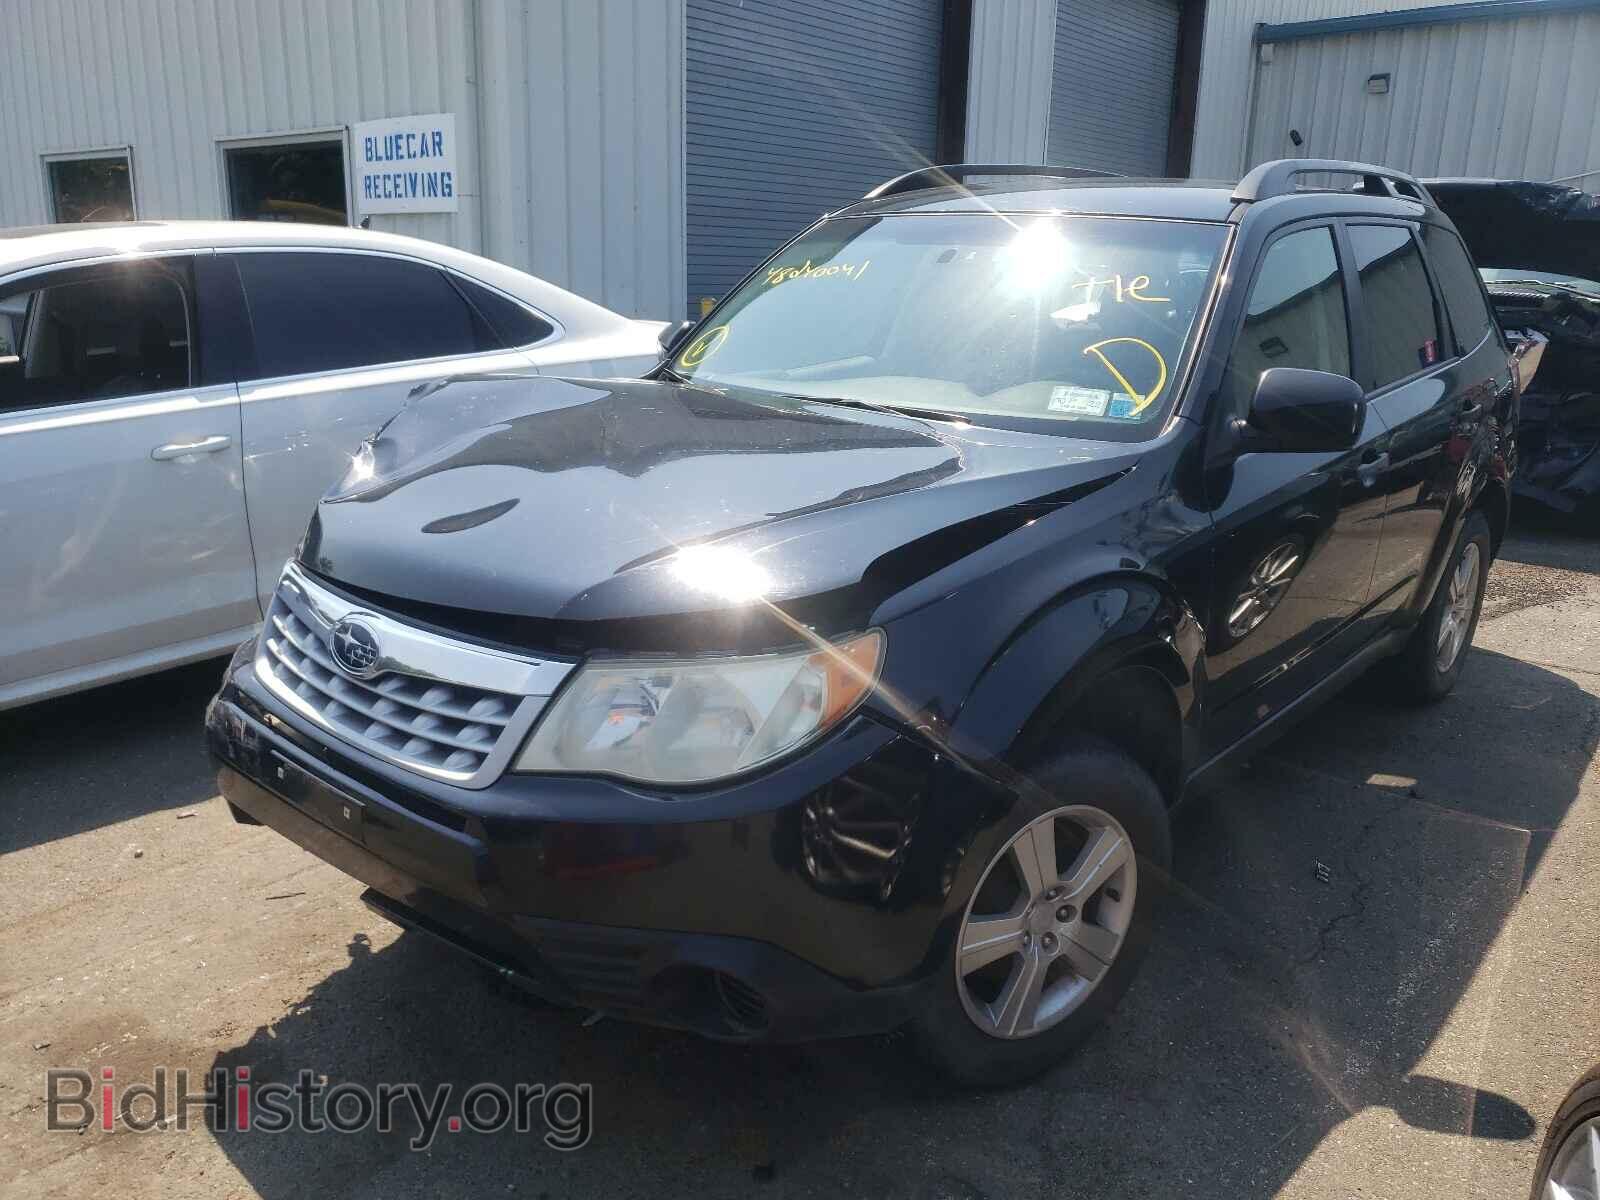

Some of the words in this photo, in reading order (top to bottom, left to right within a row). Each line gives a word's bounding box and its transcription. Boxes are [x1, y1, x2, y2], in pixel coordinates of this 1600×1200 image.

[365, 131, 443, 162] BLUECAR
[364, 171, 453, 199] RECEIVING
[1083, 337, 1167, 417] D
